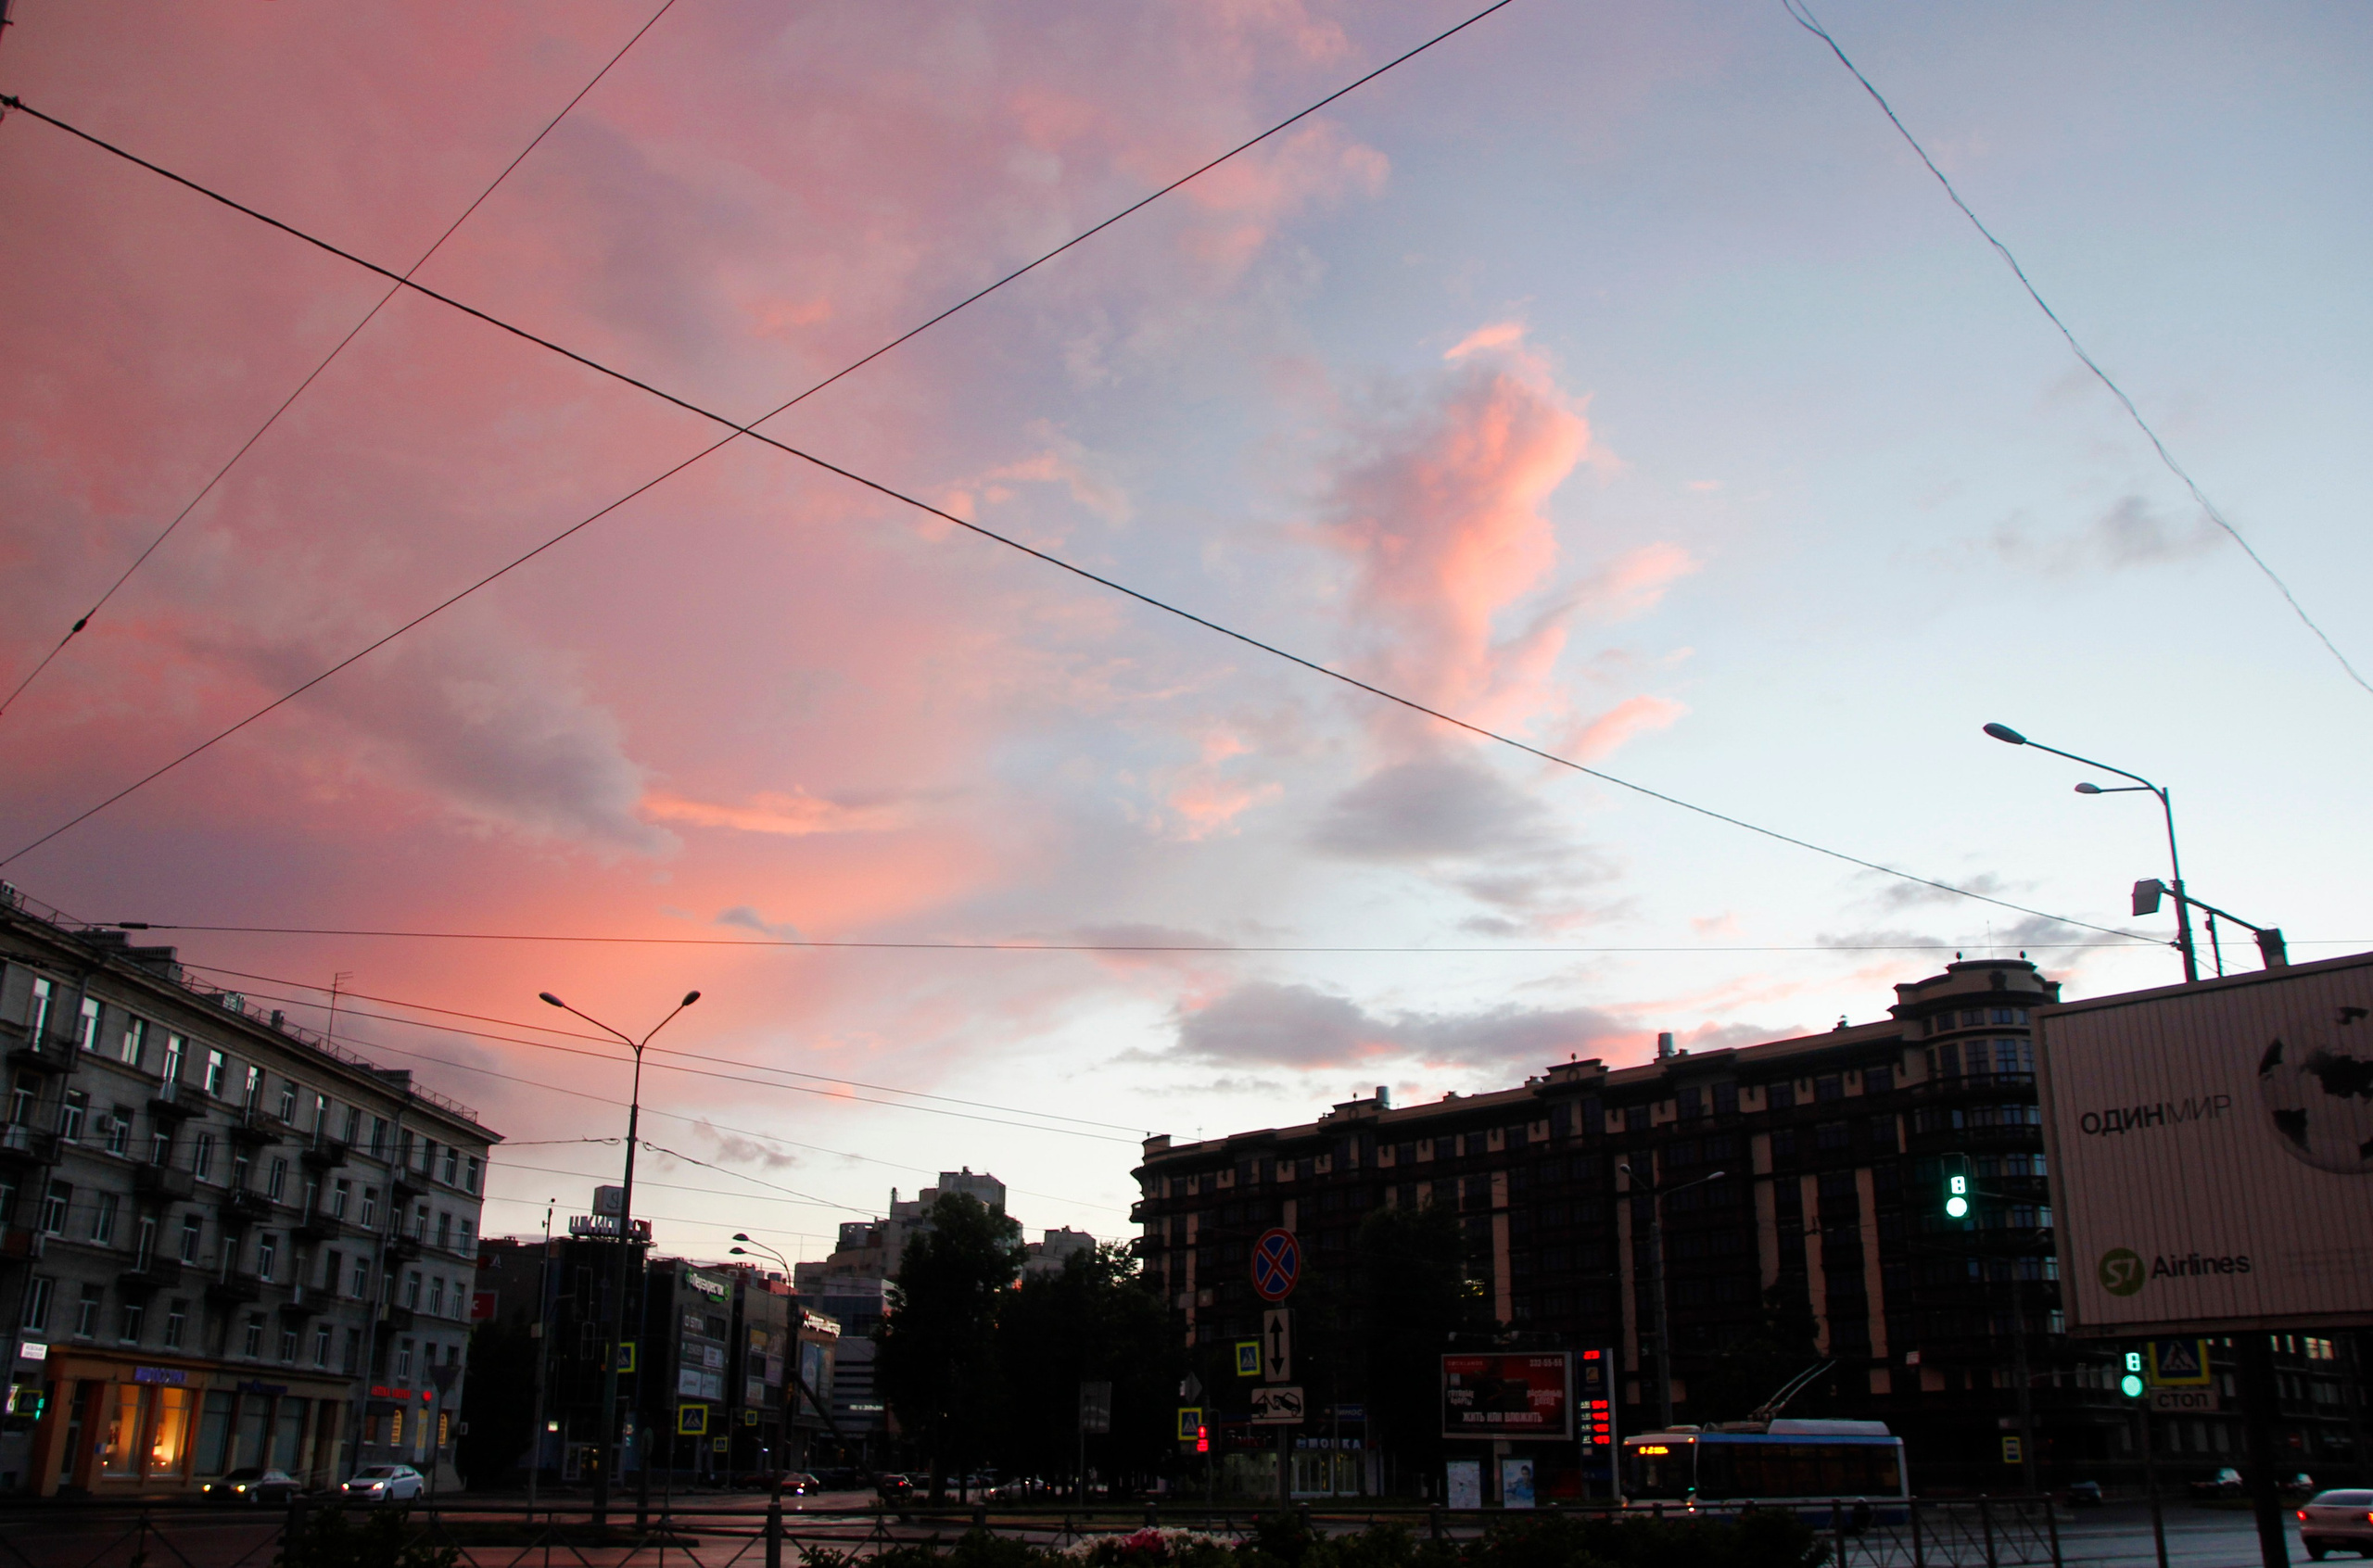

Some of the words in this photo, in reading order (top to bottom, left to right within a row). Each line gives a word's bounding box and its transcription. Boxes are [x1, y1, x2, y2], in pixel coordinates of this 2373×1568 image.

[2106, 1257, 2138, 1288] S7
[2151, 1252, 2252, 1279] Airlines
[2157, 1393, 2209, 1408] СТОП
[1462, 1411, 1485, 1423] ЖИТЬ
